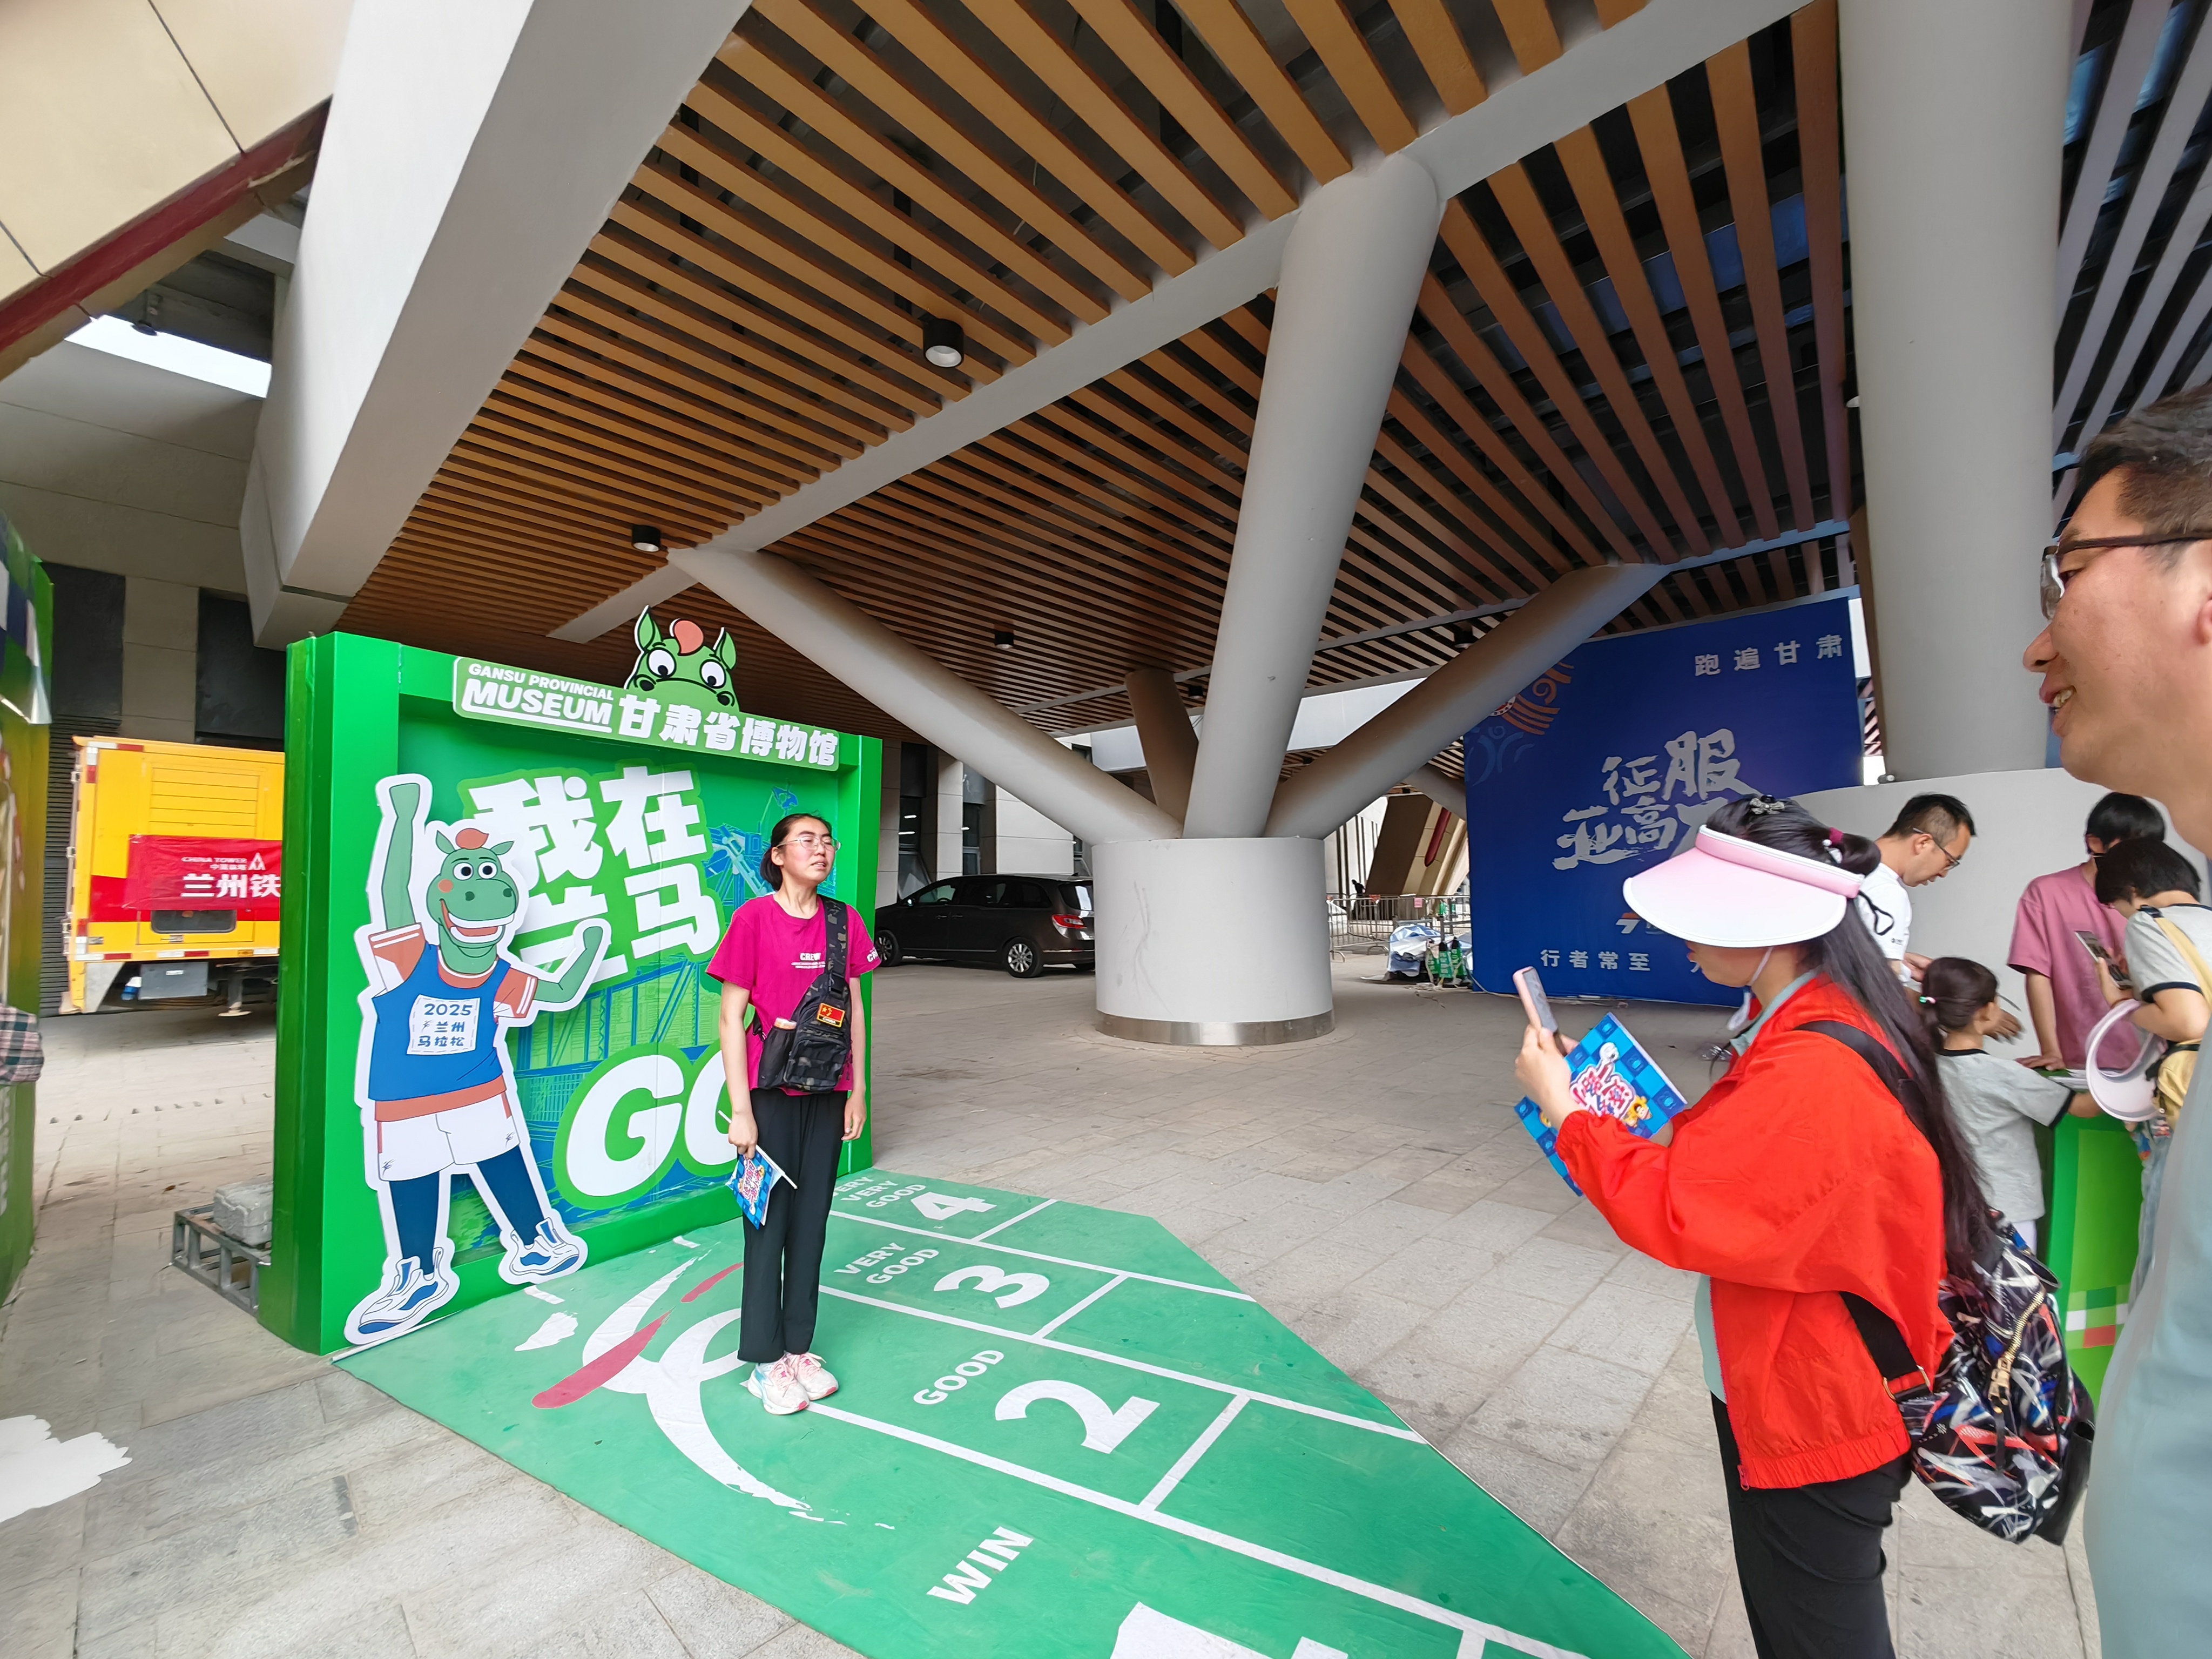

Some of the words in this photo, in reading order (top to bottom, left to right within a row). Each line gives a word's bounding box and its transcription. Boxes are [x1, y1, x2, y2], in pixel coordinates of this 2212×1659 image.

[1695, 634, 1843, 676] 跑遍甘肃
[468, 663, 525, 683] GANSU
[529, 675, 613, 700] PROVINCIAL
[462, 678, 612, 725] MUSEUM
[618, 694, 838, 766] 甘肃省博物馆
[1602, 729, 1756, 805] 征服
[468, 766, 707, 891] 我在
[180, 873, 281, 898] 兰州铁
[1540, 949, 1650, 971] 行者常至
[424, 1003, 473, 1016] 2025
[434, 1021, 465, 1033] 兰州
[417, 1035, 465, 1047] 马拉松
[833, 1176, 874, 1197] ERY
[840, 1181, 899, 1201] VERY
[866, 1184, 926, 1208] GOOD
[911, 1191, 997, 1220] 4
[834, 1242, 906, 1274] VERY
[866, 1249, 939, 1284] GOOD
[934, 1265, 1050, 1309] 3
[913, 1350, 1004, 1405] GOOD
[995, 1380, 1161, 1454] 2
[926, 1526, 1034, 1604] WIN
